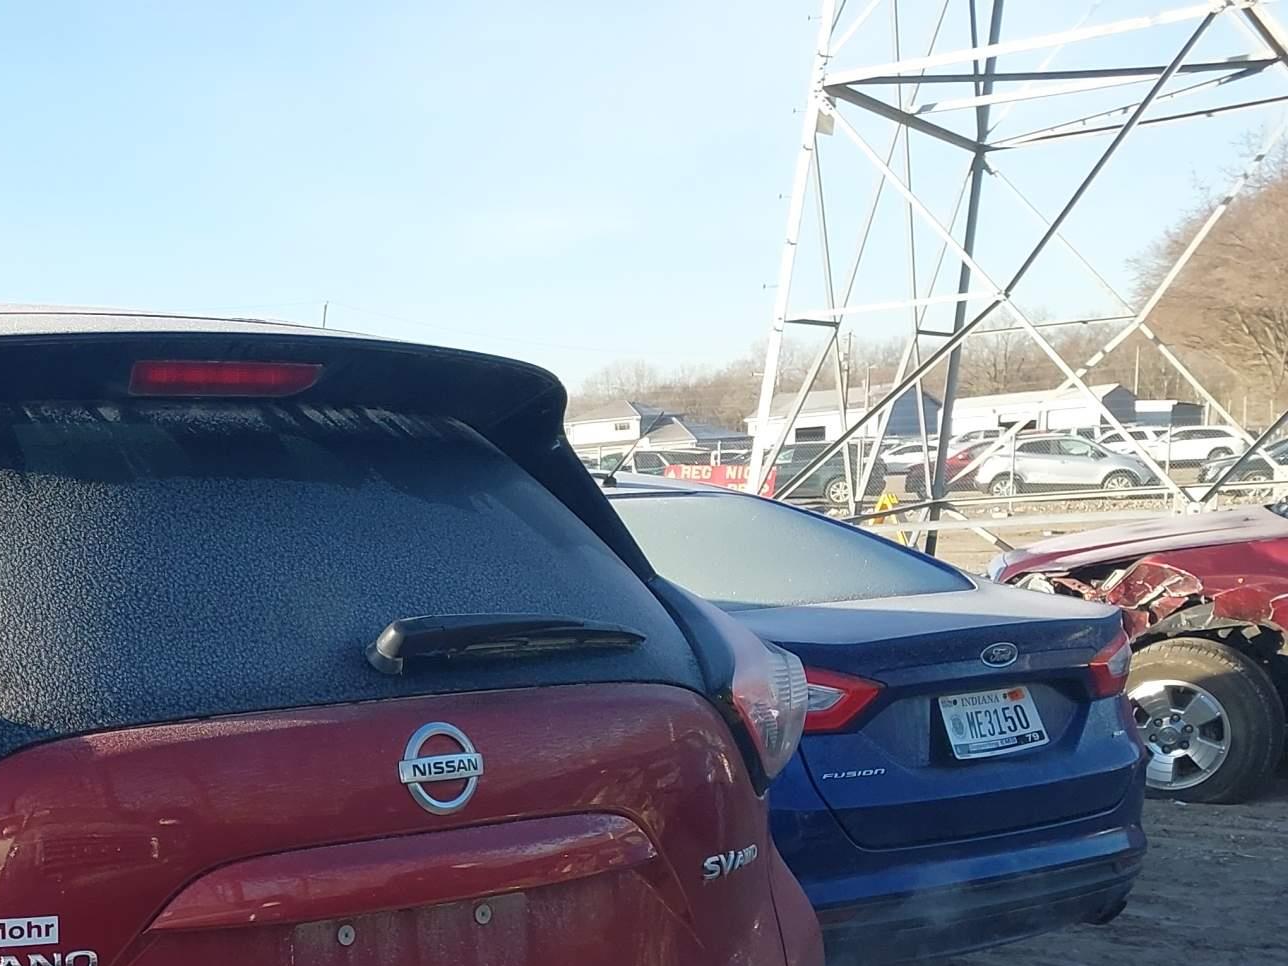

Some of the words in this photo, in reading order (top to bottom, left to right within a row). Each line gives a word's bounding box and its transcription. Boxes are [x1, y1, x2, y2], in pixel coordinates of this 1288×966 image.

[960, 694, 1000, 707] INDIANA
[1024, 731, 1040, 743] 79
[411, 756, 479, 778] NISSAN
[822, 767, 886, 780] FUSION
